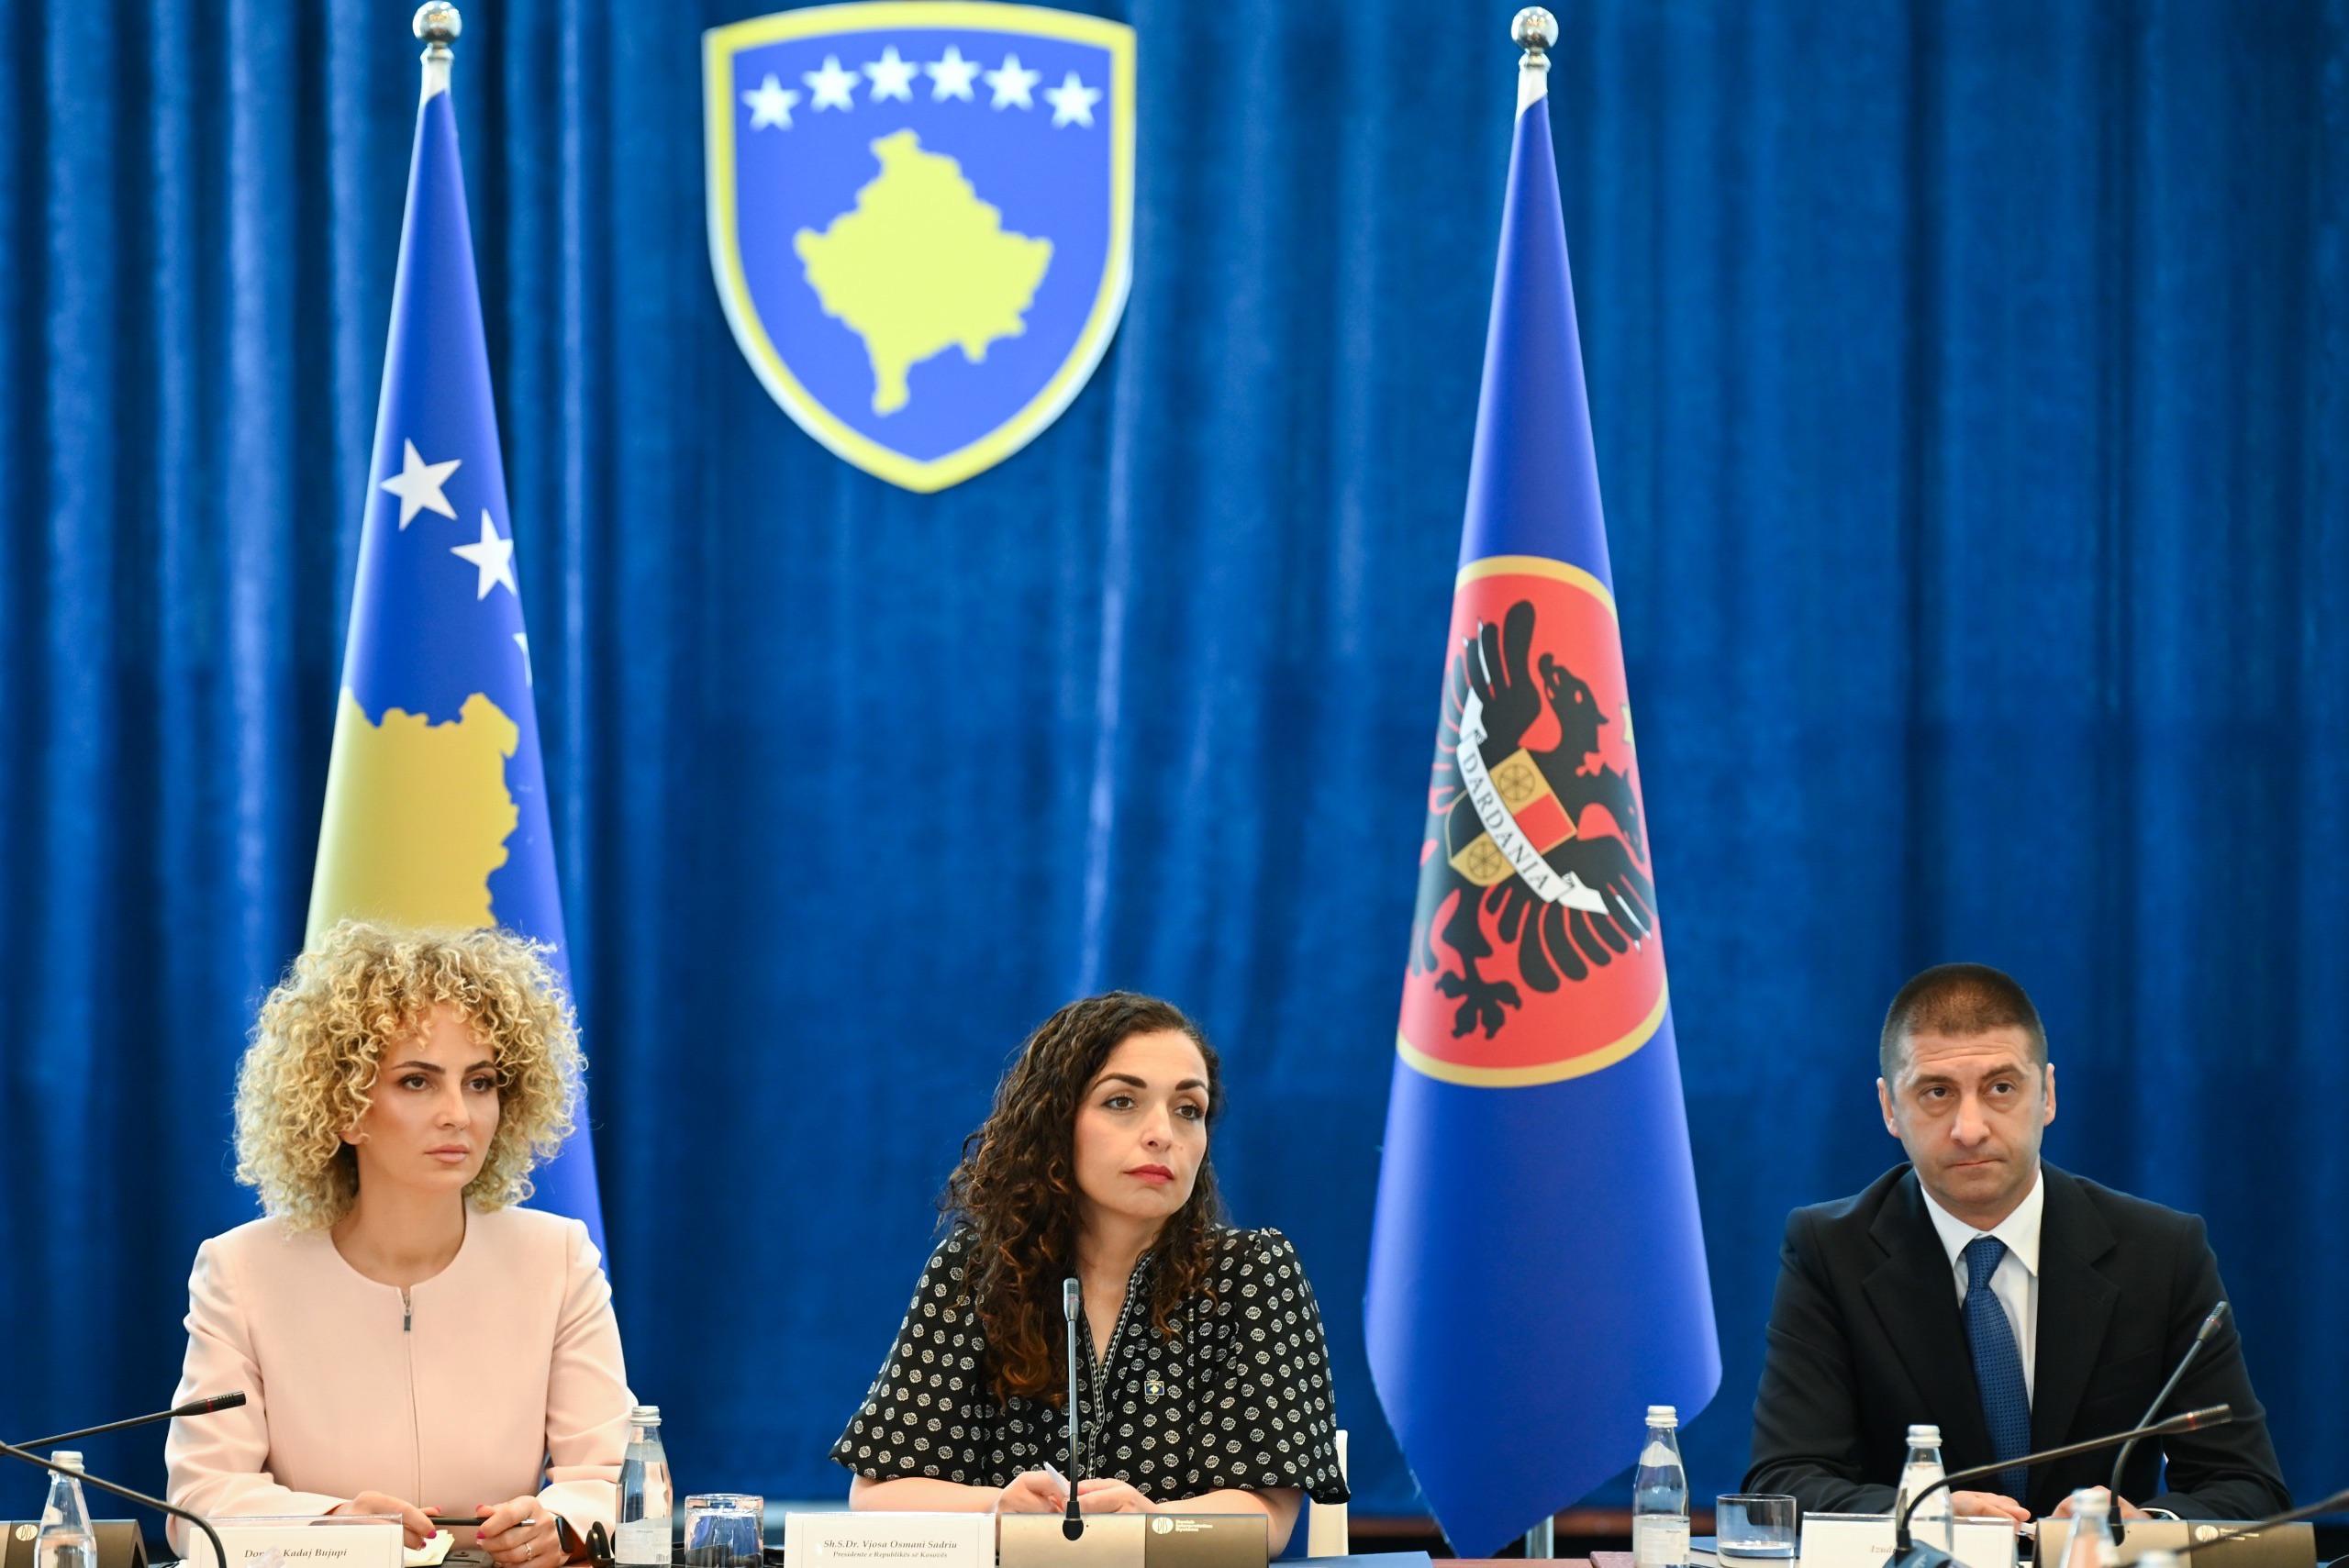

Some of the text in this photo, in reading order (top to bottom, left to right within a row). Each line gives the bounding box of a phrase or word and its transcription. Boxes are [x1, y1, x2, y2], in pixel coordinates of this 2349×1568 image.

[1461, 751, 1552, 892] DARDANIA
[863, 1540, 887, 1551] Vjosa
[890, 1540, 925, 1549] Osmani
[928, 1540, 957, 1549] Sadriu
[283, 1549, 313, 1559] Kadaj
[315, 1549, 348, 1559] Bujupi
